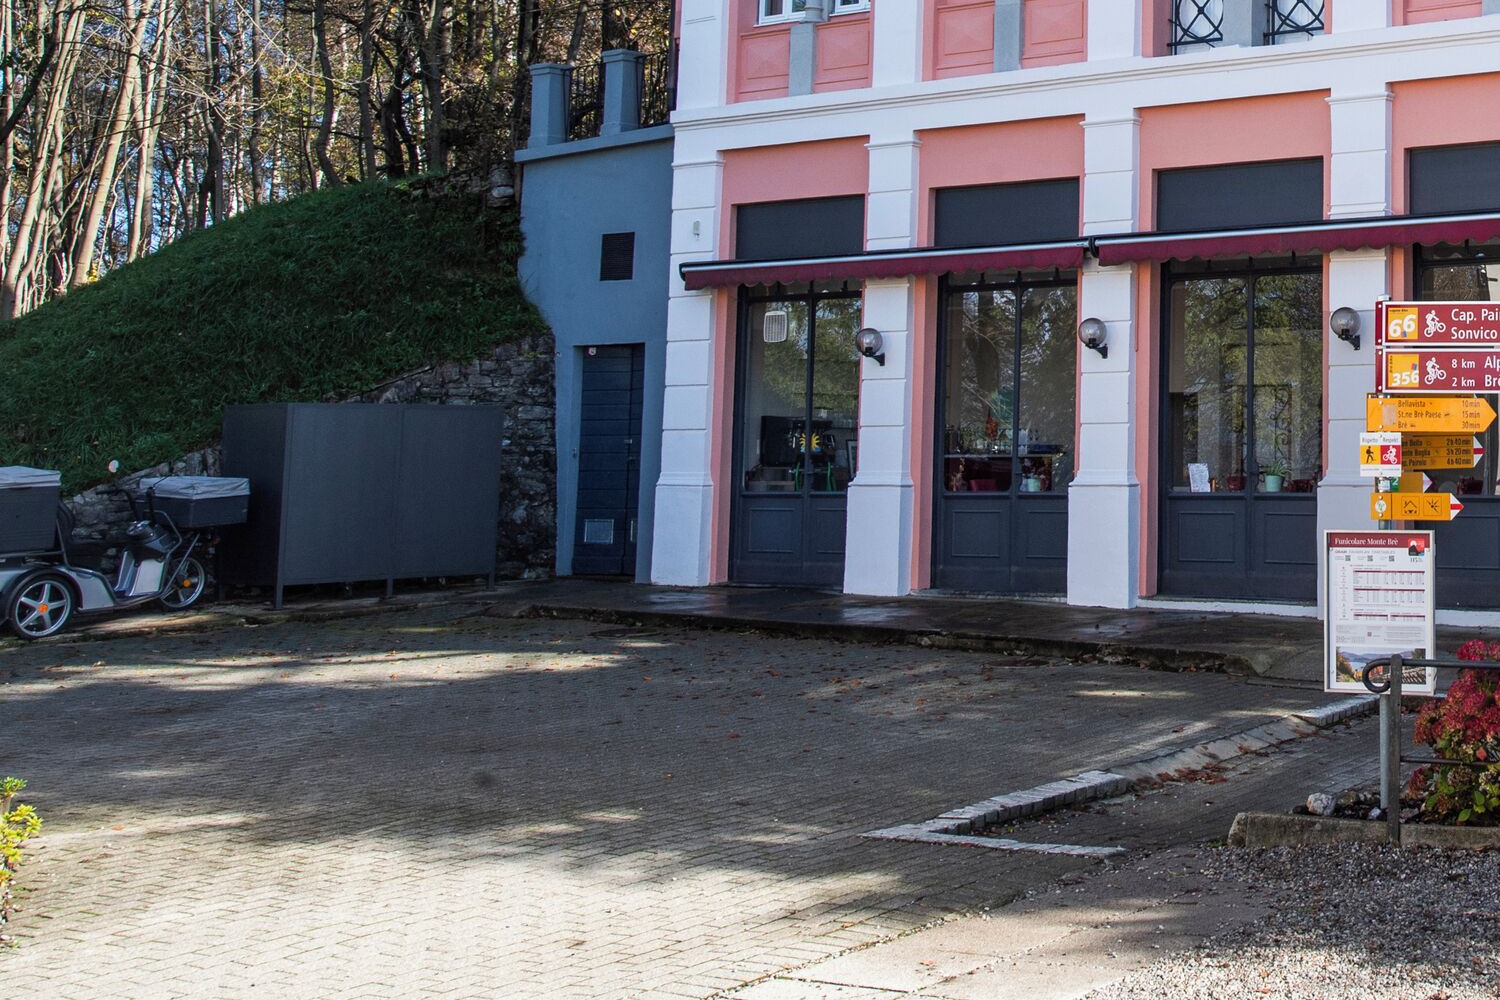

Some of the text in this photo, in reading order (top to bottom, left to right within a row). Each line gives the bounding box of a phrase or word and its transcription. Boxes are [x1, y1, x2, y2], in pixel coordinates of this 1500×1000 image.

[1451, 309, 1477, 323] Cap.
[1388, 314, 1416, 337] 66
[1451, 327, 1498, 340] Sonvico
[1451, 359, 1457, 368] 8
[1461, 358, 1475, 368] km
[1392, 370, 1419, 386] 356
[1451, 378, 1458, 387] 2
[1461, 377, 1475, 387] km
[1335, 537, 1367, 545] Funicolare
